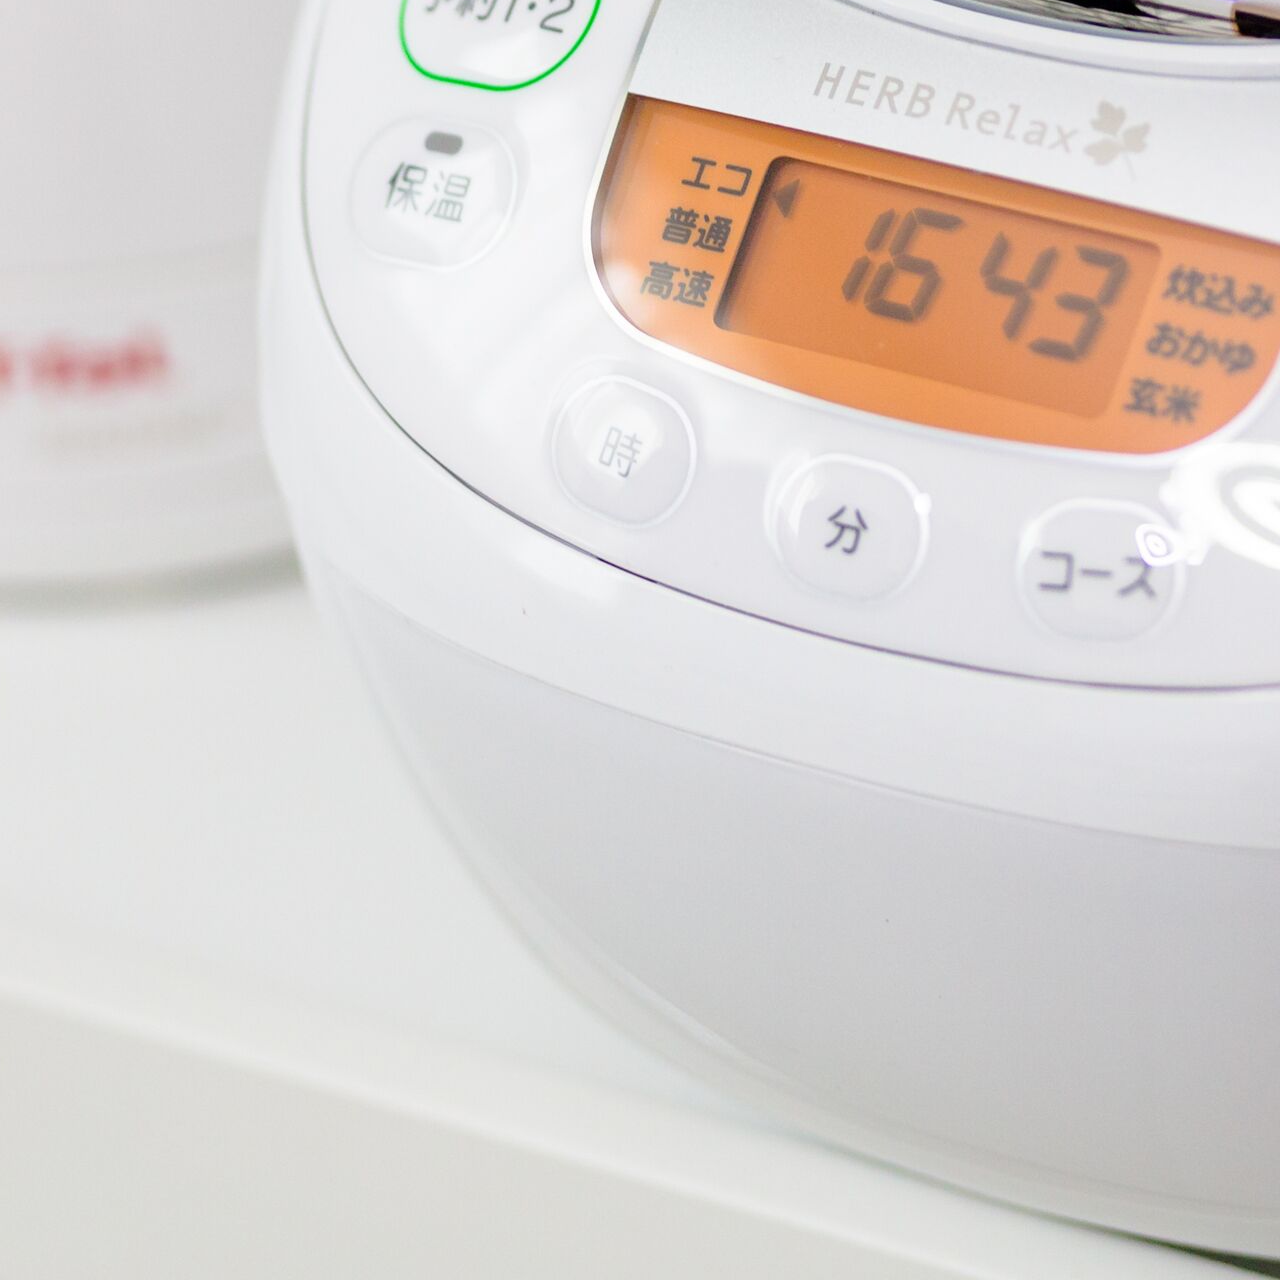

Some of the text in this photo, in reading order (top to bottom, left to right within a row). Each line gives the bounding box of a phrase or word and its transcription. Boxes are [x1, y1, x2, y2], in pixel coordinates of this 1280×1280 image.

[813, 61, 1079, 153] HERB Relax
[385, 161, 472, 224] 保温
[681, 157, 753, 197] エコ
[661, 206, 732, 254] 普通
[641, 261, 715, 308] 高速
[1161, 264, 1275, 320] 炊込み
[1146, 322, 1257, 373] おかゆ
[1124, 378, 1204, 423] 玄米
[598, 426, 644, 479] 時
[824, 505, 868, 556] 分
[1037, 549, 1158, 599] コース
